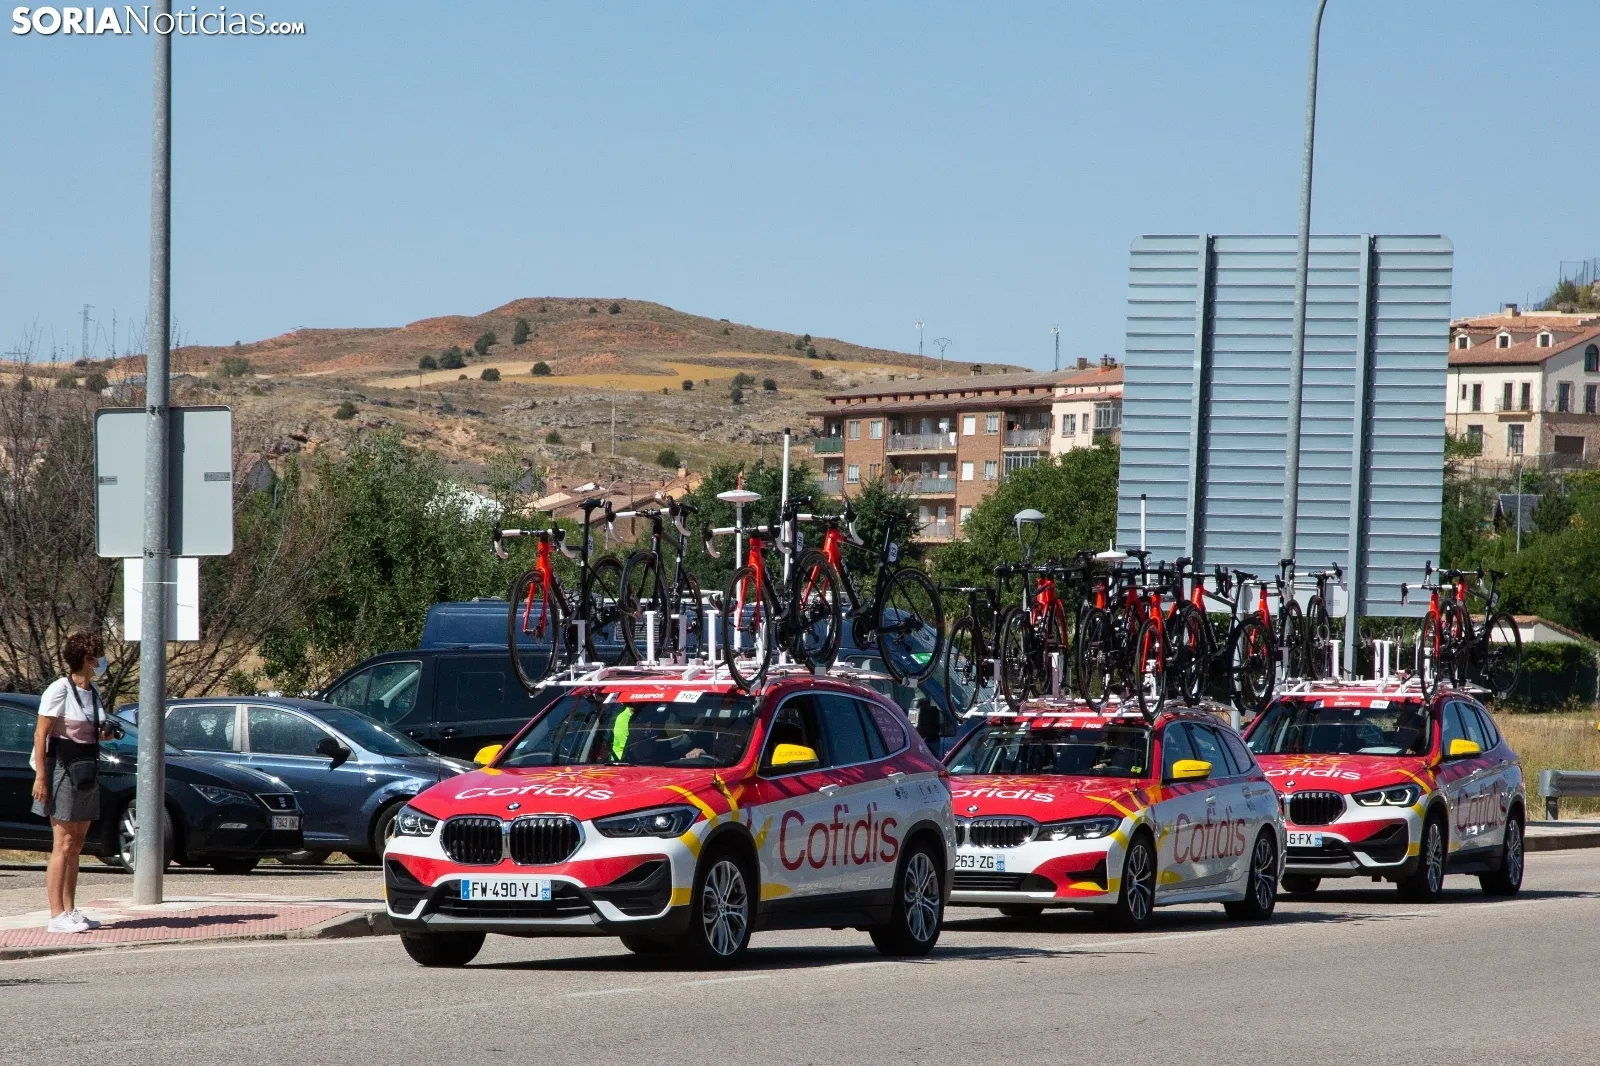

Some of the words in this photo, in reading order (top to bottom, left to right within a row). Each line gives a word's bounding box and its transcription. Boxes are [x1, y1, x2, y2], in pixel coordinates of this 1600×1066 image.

[1264, 766, 1361, 780] ofidis
[951, 786, 1056, 803] ofidis
[779, 802, 899, 871] Cofidis
[1174, 805, 1246, 864] Cofidis
[1290, 833, 1312, 845] 6-FX
[472, 882, 539, 898] FW-490-YJ
